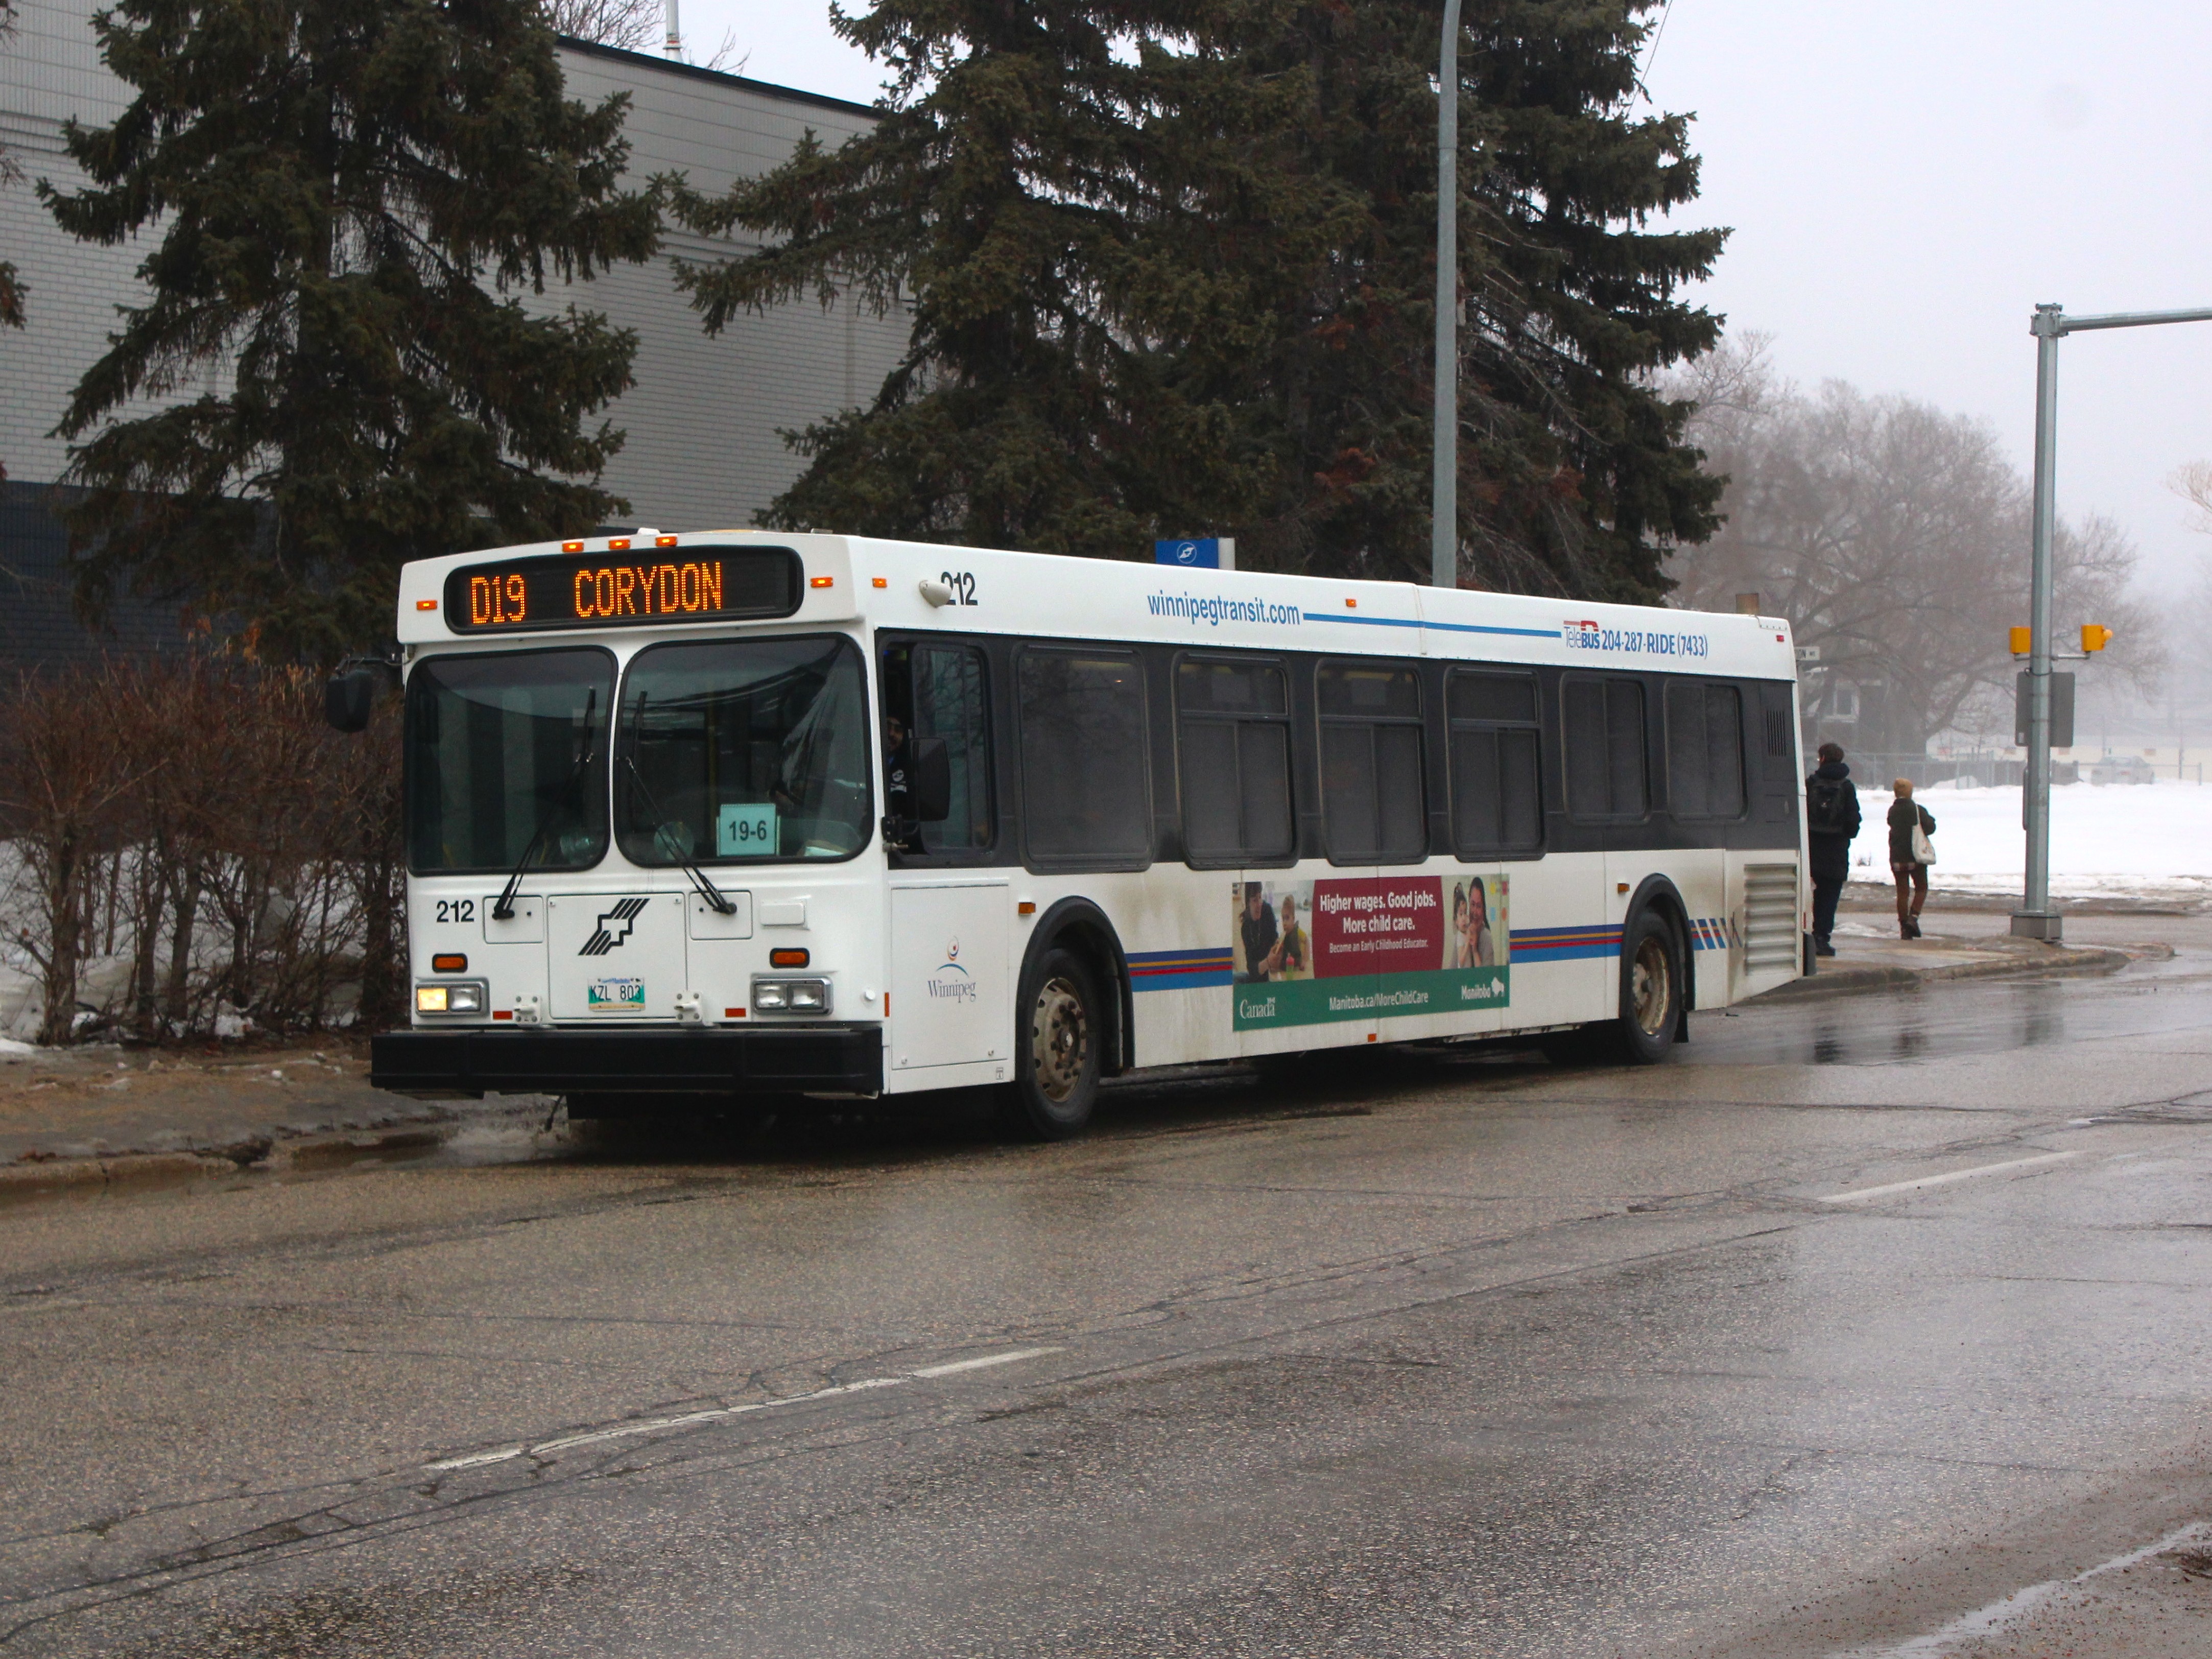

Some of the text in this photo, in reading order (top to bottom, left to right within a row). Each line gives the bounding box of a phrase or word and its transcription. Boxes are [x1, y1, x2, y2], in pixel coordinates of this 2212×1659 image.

[470, 561, 722, 625] D19 CORYDON
[941, 572, 978, 606] 212
[1147, 589, 1301, 627] winnipegtransit.com
[1563, 626, 1600, 650] TeleBUS
[1677, 631, 1708, 660] (7433)
[729, 820, 767, 842] 19-6
[436, 899, 475, 923] 212
[1319, 890, 1437, 915] Higher wages. Good jobs.
[1342, 914, 1416, 934] More child care.
[1329, 942, 1352, 954] Become
[1352, 943, 1360, 952] an
[1361, 940, 1374, 954] Early
[1375, 938, 1402, 951] Childhood
[590, 985, 641, 1001] KZL 803
[927, 979, 977, 1003] Winnipeg
[1329, 990, 1429, 1011] Manitoba.ca/MoreChildCare
[1240, 998, 1276, 1020] Canada
